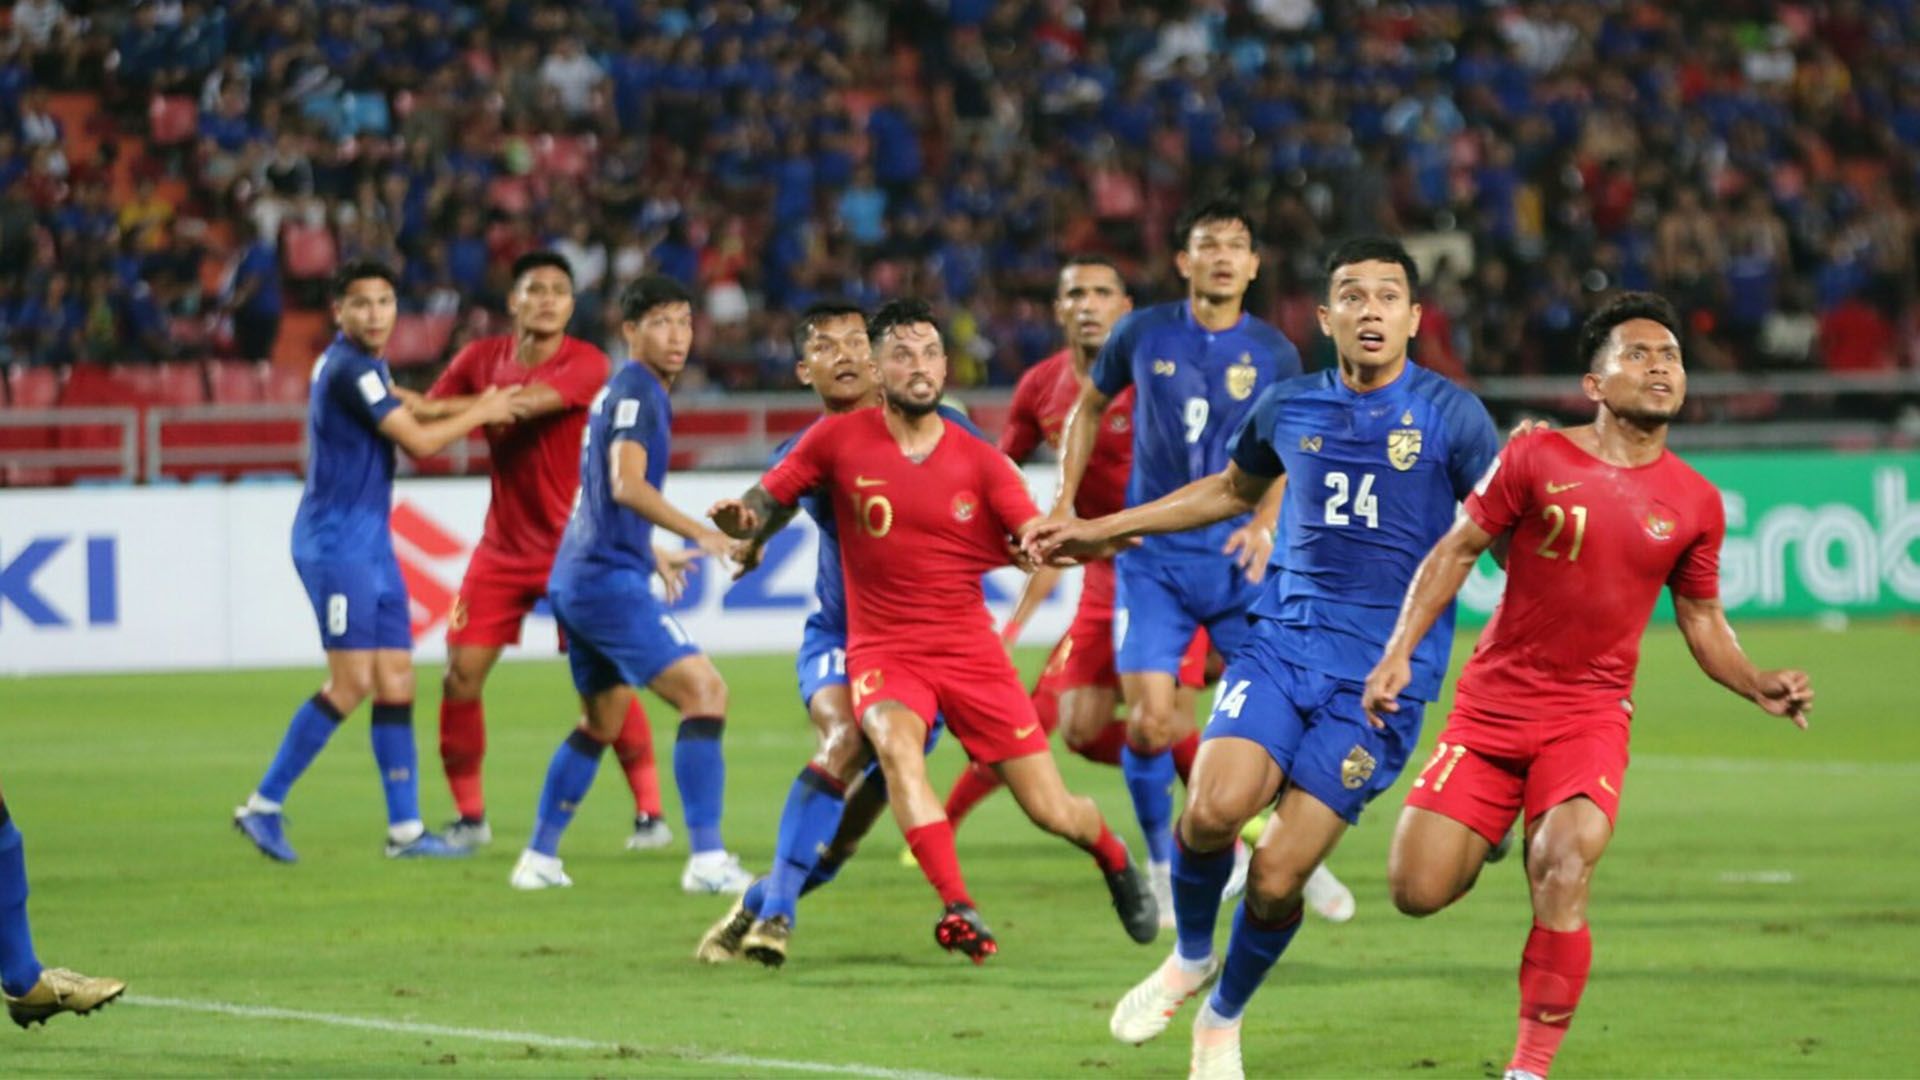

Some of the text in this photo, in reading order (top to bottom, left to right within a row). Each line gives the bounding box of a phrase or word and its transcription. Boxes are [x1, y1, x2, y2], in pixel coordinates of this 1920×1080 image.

[1184, 397, 1209, 443] 9
[850, 492, 893, 538] 10
[1324, 471, 1378, 528] 24
[1536, 504, 1587, 561] 21
[0, 537, 118, 625] KI
[328, 593, 348, 636] 8
[660, 614, 695, 646] 1
[1413, 742, 1467, 792] 21
